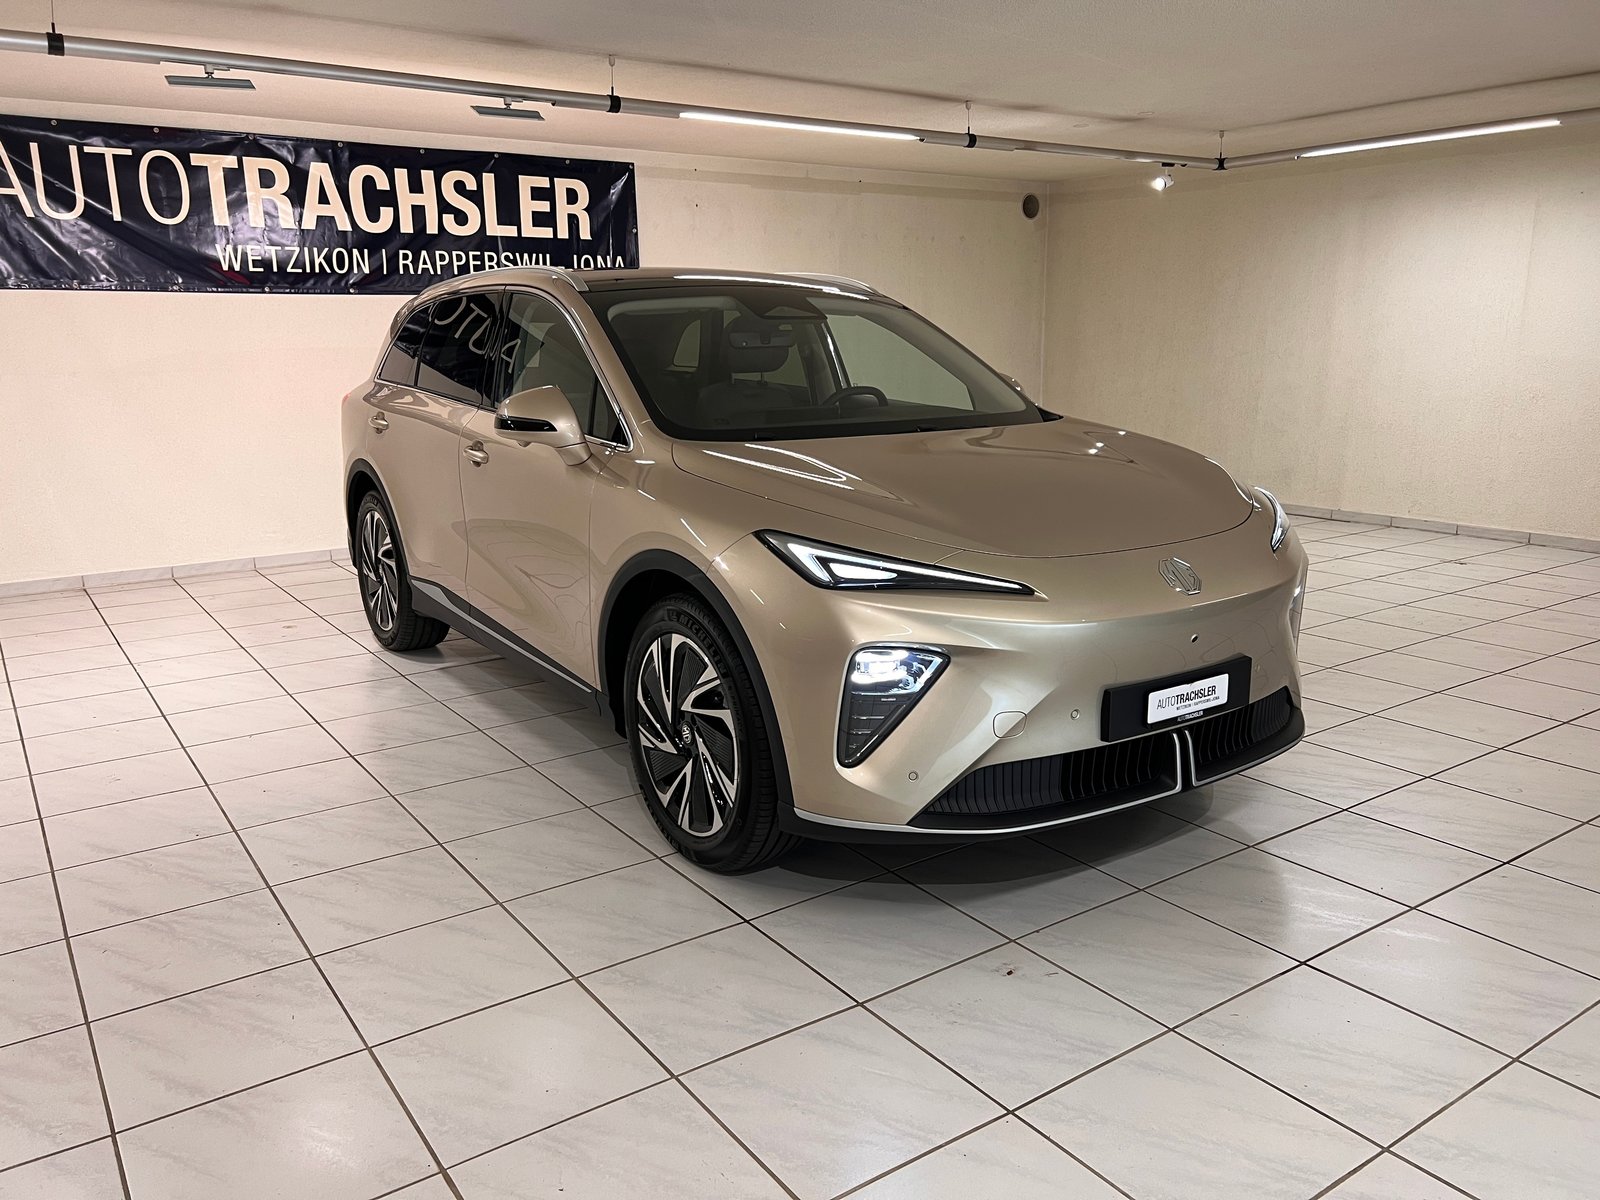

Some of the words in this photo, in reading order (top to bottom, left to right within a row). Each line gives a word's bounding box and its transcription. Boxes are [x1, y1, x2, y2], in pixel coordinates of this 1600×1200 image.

[215, 244, 370, 274] WETZIKON
[678, 613, 728, 674] MICHELIN
[1157, 685, 1216, 709] AUTOTRACHSLER
